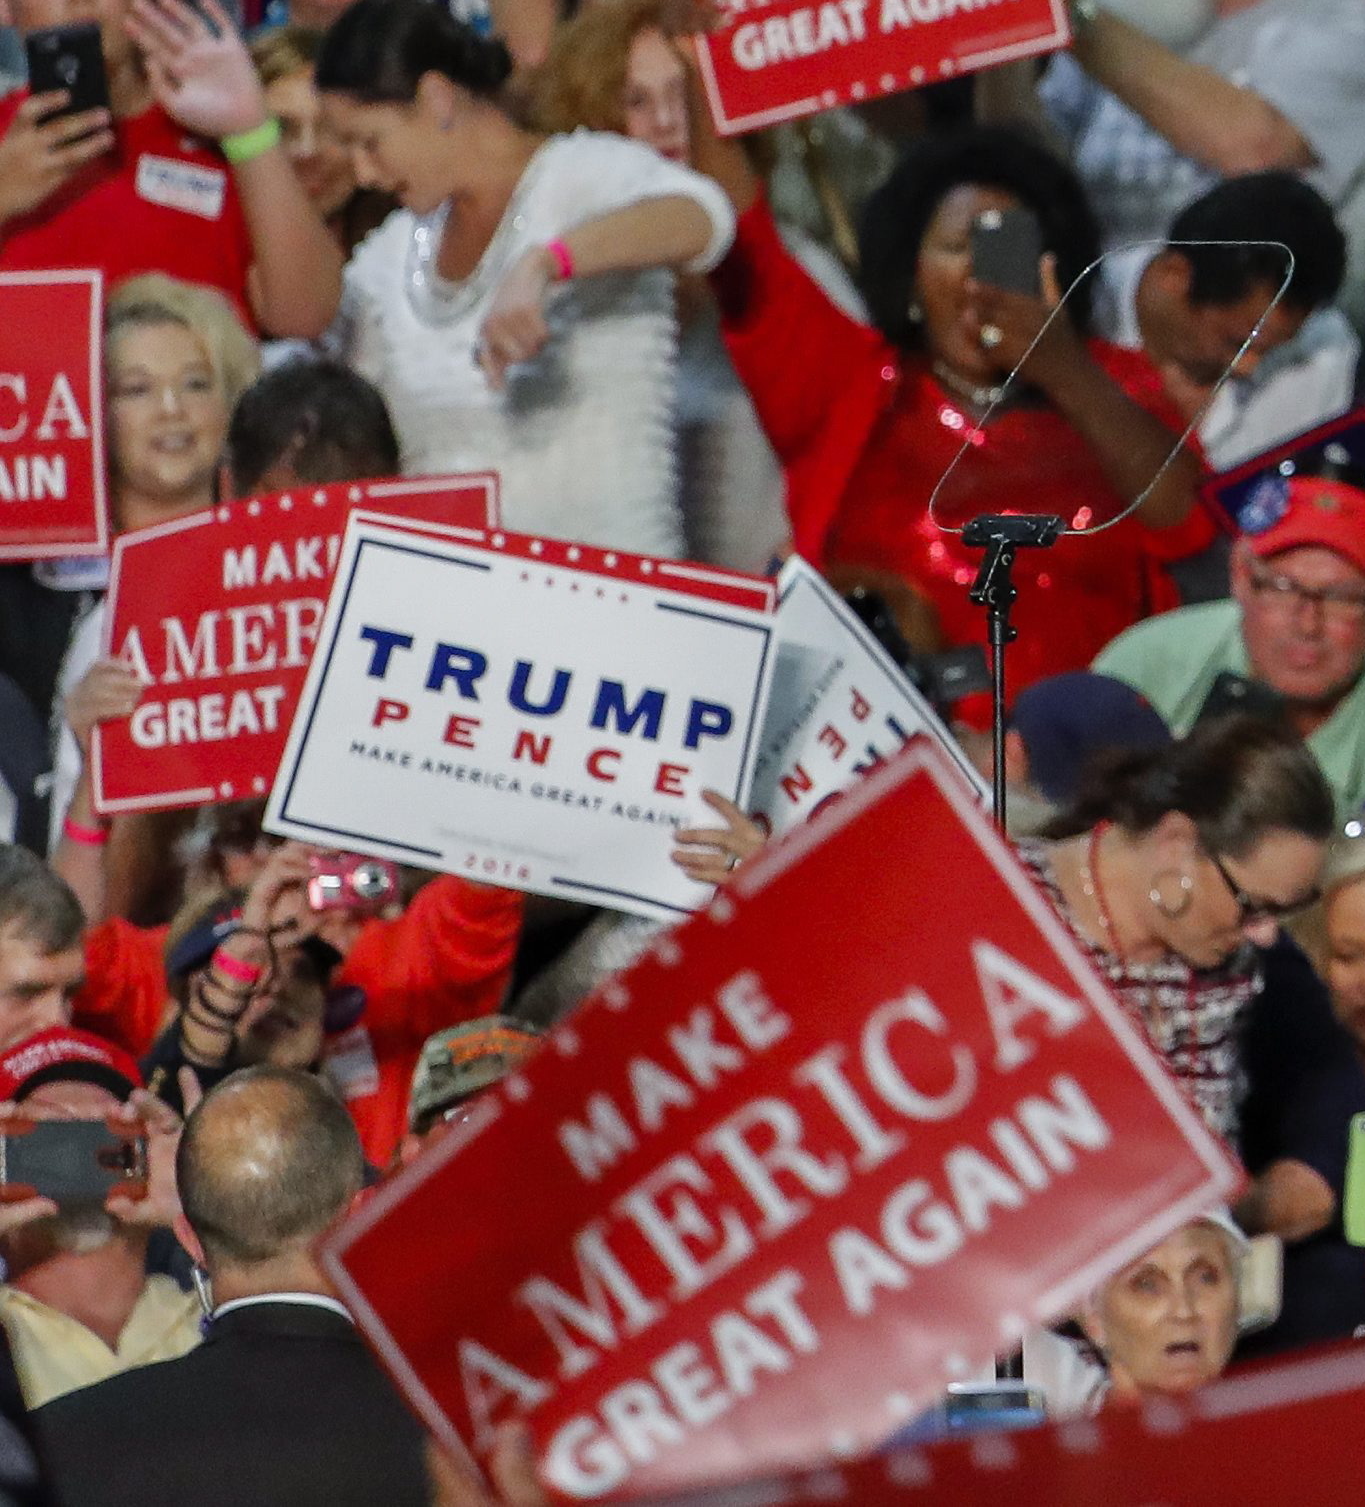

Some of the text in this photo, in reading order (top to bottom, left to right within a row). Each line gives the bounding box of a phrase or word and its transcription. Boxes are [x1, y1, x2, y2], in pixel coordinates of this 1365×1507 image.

[130, 685, 286, 748] GREAT
[358, 624, 733, 751] TRUMP
[372, 697, 690, 797] PENCE
[349, 740, 412, 769] MAKE
[420, 756, 522, 792] AMERICA
[529, 782, 603, 811] GREAT
[556, 971, 792, 1184] MAKE
[459, 939, 1089, 1457] AMERICA
[542, 1074, 1113, 1500] GREAT AGAIN
